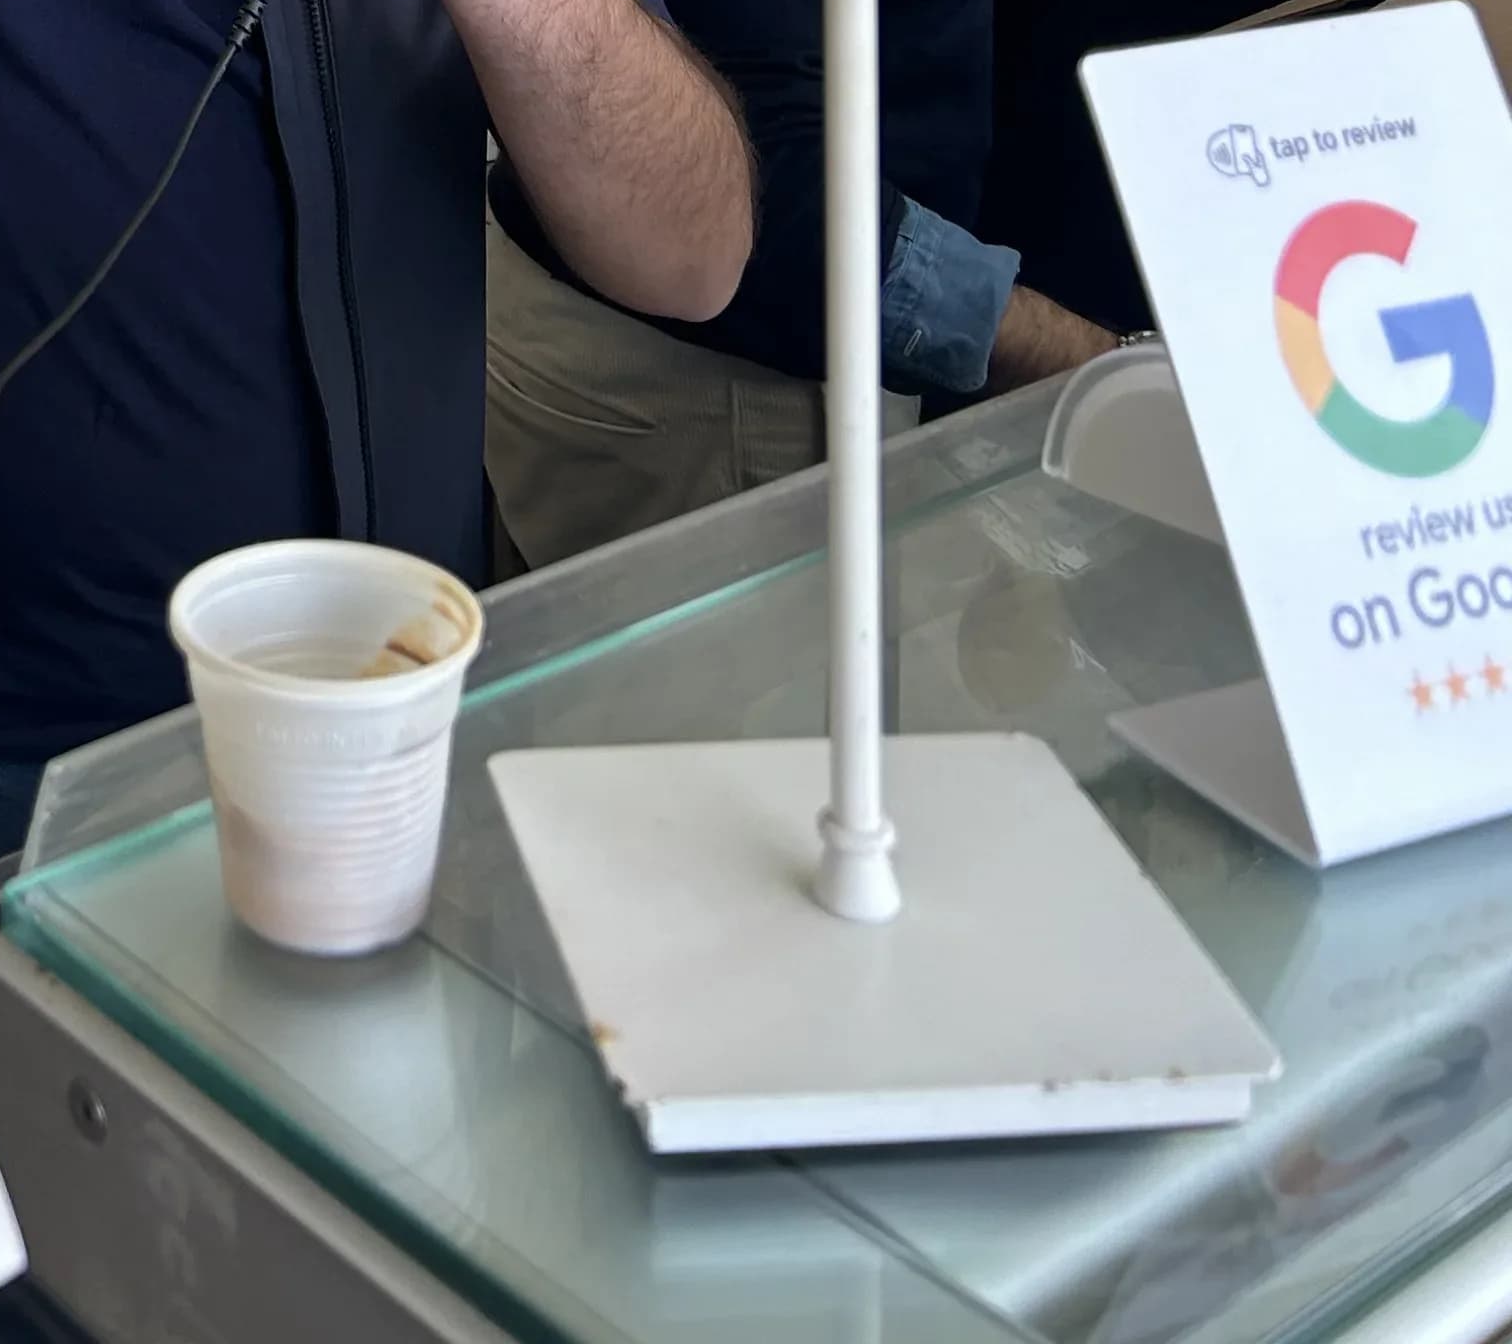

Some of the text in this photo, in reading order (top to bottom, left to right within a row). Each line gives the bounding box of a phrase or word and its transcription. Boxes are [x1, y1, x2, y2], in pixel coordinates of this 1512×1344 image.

[1269, 116, 1417, 163] tap to review
[1273, 199, 1495, 479] G
[1360, 502, 1474, 559] review
[1331, 595, 1401, 649] on
